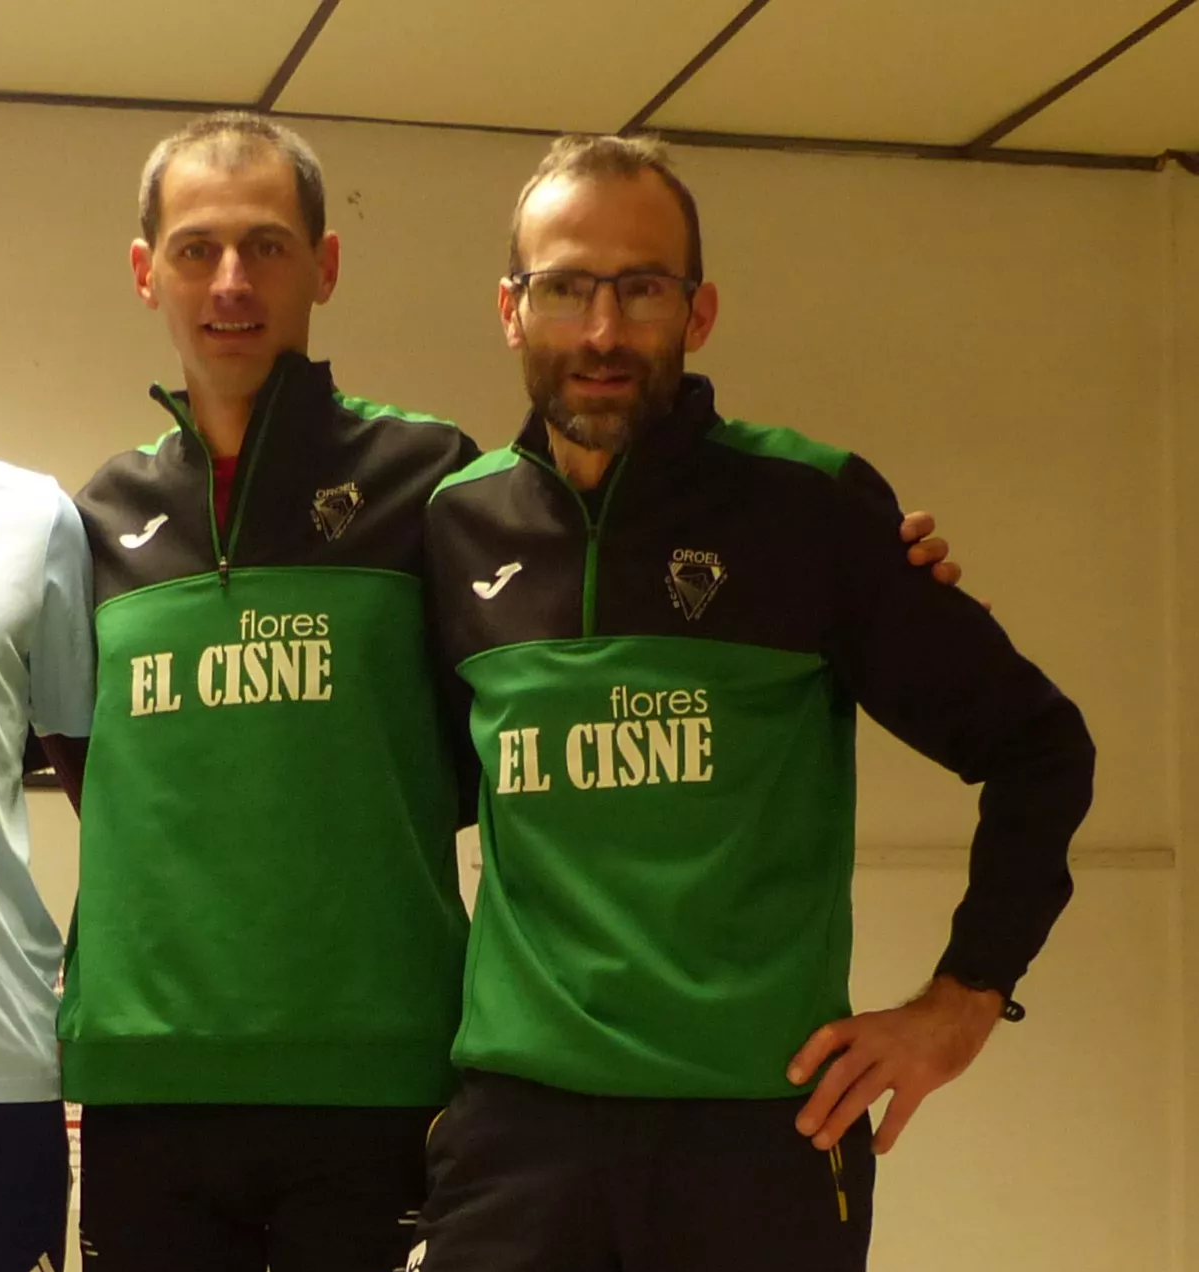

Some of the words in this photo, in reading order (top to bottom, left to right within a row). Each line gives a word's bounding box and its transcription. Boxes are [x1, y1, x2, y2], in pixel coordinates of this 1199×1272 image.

[672, 548, 721, 566] OROEL
[240, 609, 329, 640] flores
[130, 652, 182, 717] EL
[197, 639, 333, 708] CISNE
[610, 685, 709, 719] flores
[497, 727, 551, 795] EL
[565, 717, 714, 790] CISNE
